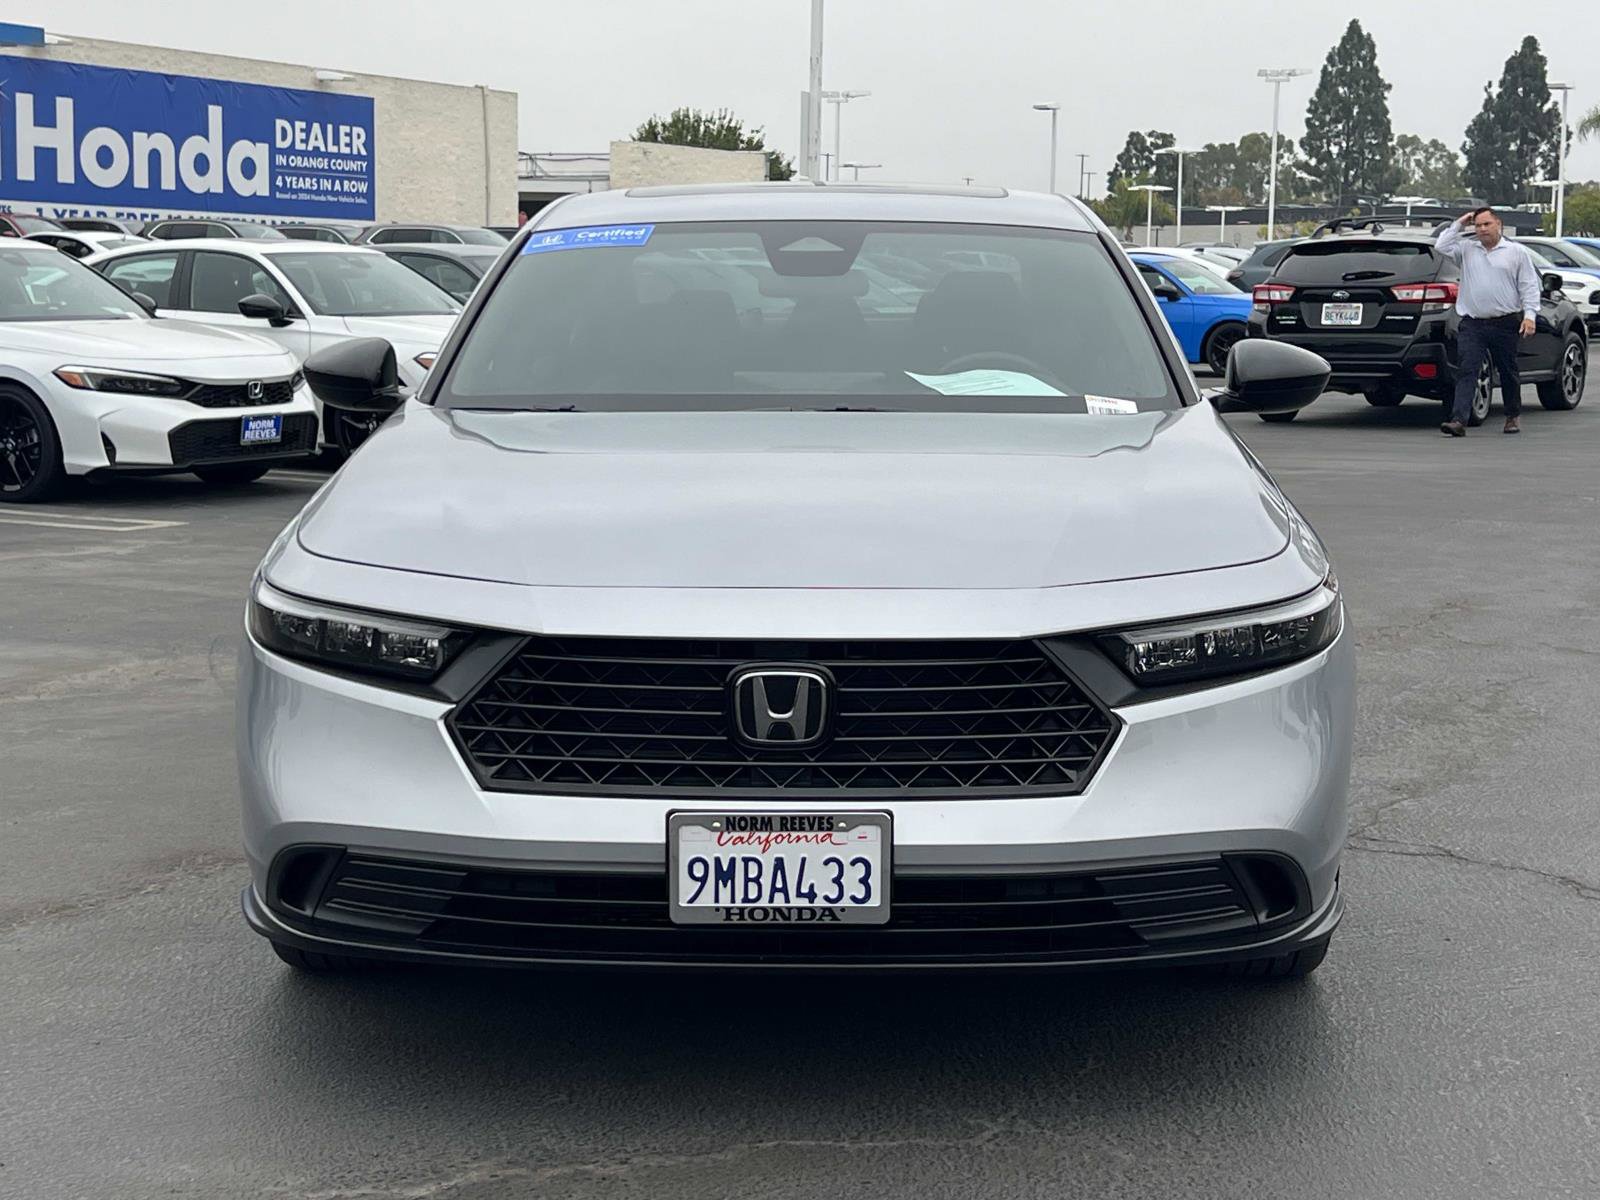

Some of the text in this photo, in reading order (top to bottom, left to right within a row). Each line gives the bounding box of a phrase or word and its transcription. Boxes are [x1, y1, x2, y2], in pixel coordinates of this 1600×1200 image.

[15, 92, 270, 197] Honda
[275, 118, 367, 156] DEALER
[275, 154, 367, 172] IN ORANGE COUNTY
[275, 175, 369, 194] 4 YEARS IN A ROW
[576, 228, 646, 239] Certified
[248, 419, 275, 430] NORM
[244, 428, 277, 440] REEVES
[725, 816, 834, 831] NORM REEVES
[717, 831, 848, 854] California
[686, 856, 872, 904] 9MBA433
[723, 907, 841, 922] HONDA
